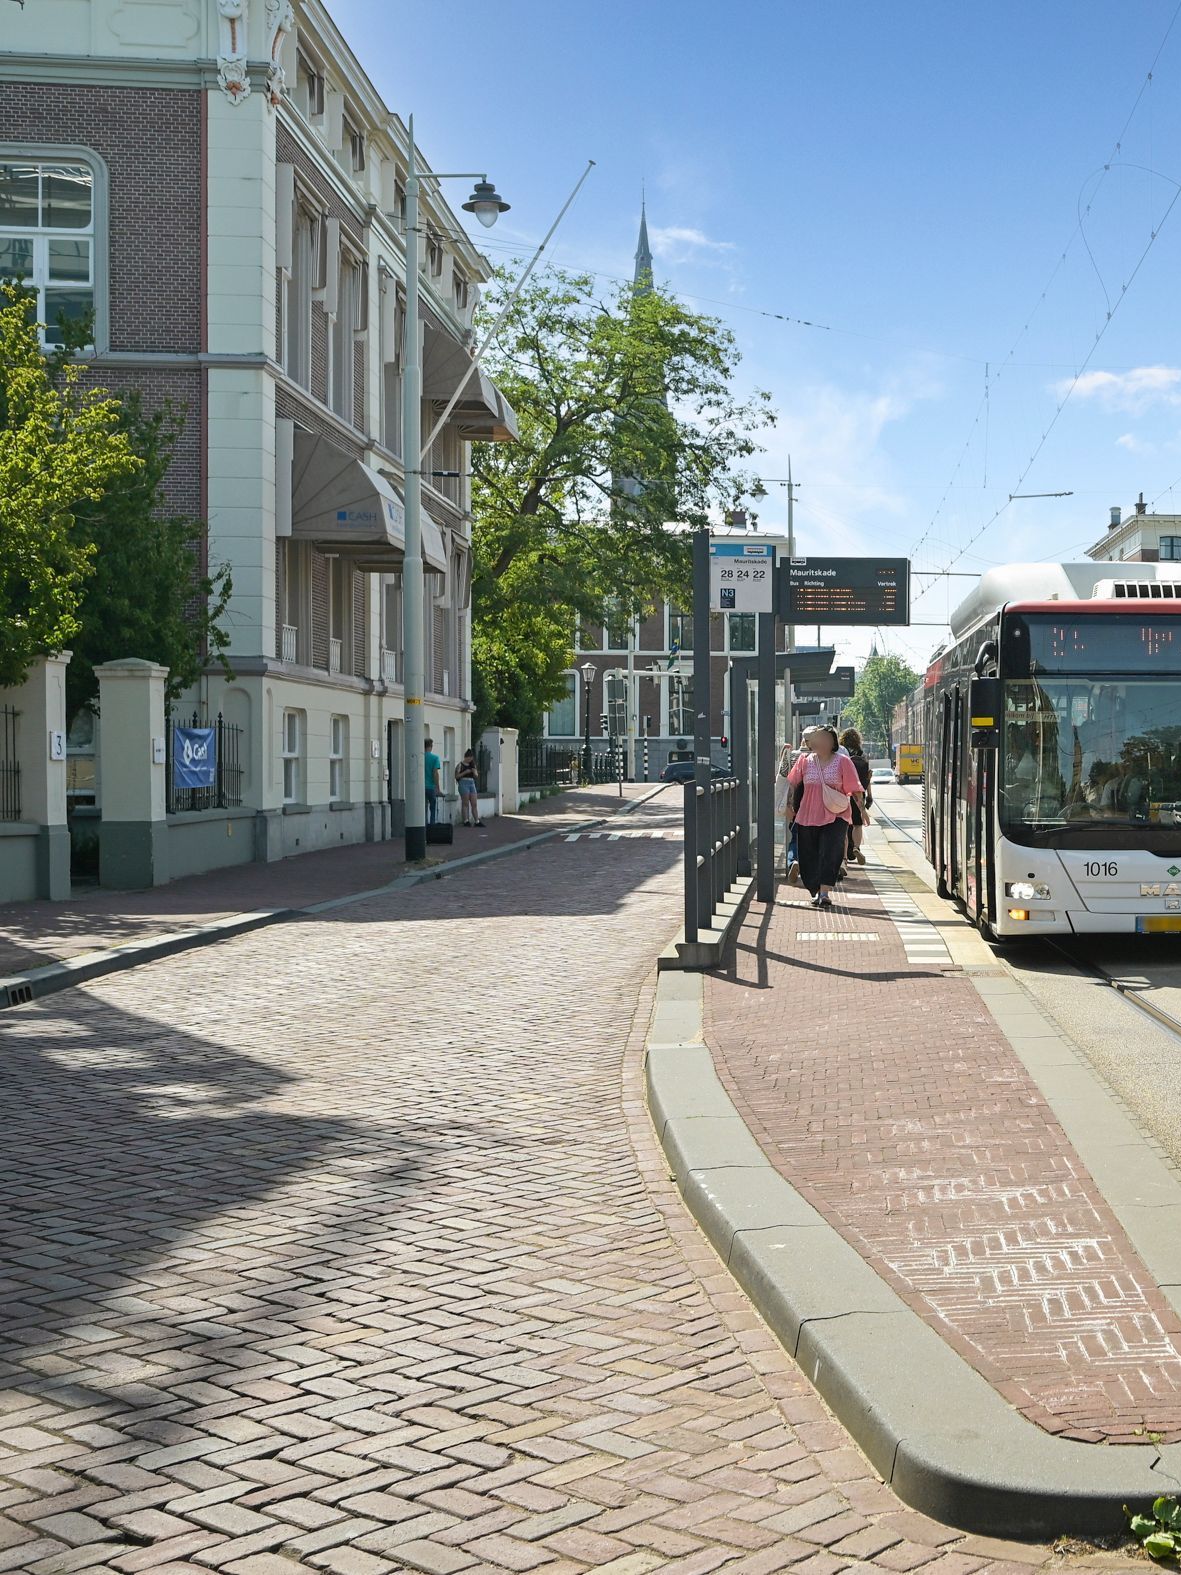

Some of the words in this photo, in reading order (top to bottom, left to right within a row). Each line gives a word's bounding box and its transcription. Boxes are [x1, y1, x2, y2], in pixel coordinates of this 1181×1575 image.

[720, 569, 734, 579] 28
[736, 570, 750, 579] 24
[752, 570, 766, 579] 22
[790, 569, 837, 577] Mauritskade
[721, 589, 734, 597] N3
[56, 735, 62, 755] 3
[1083, 861, 1118, 877] 1016
